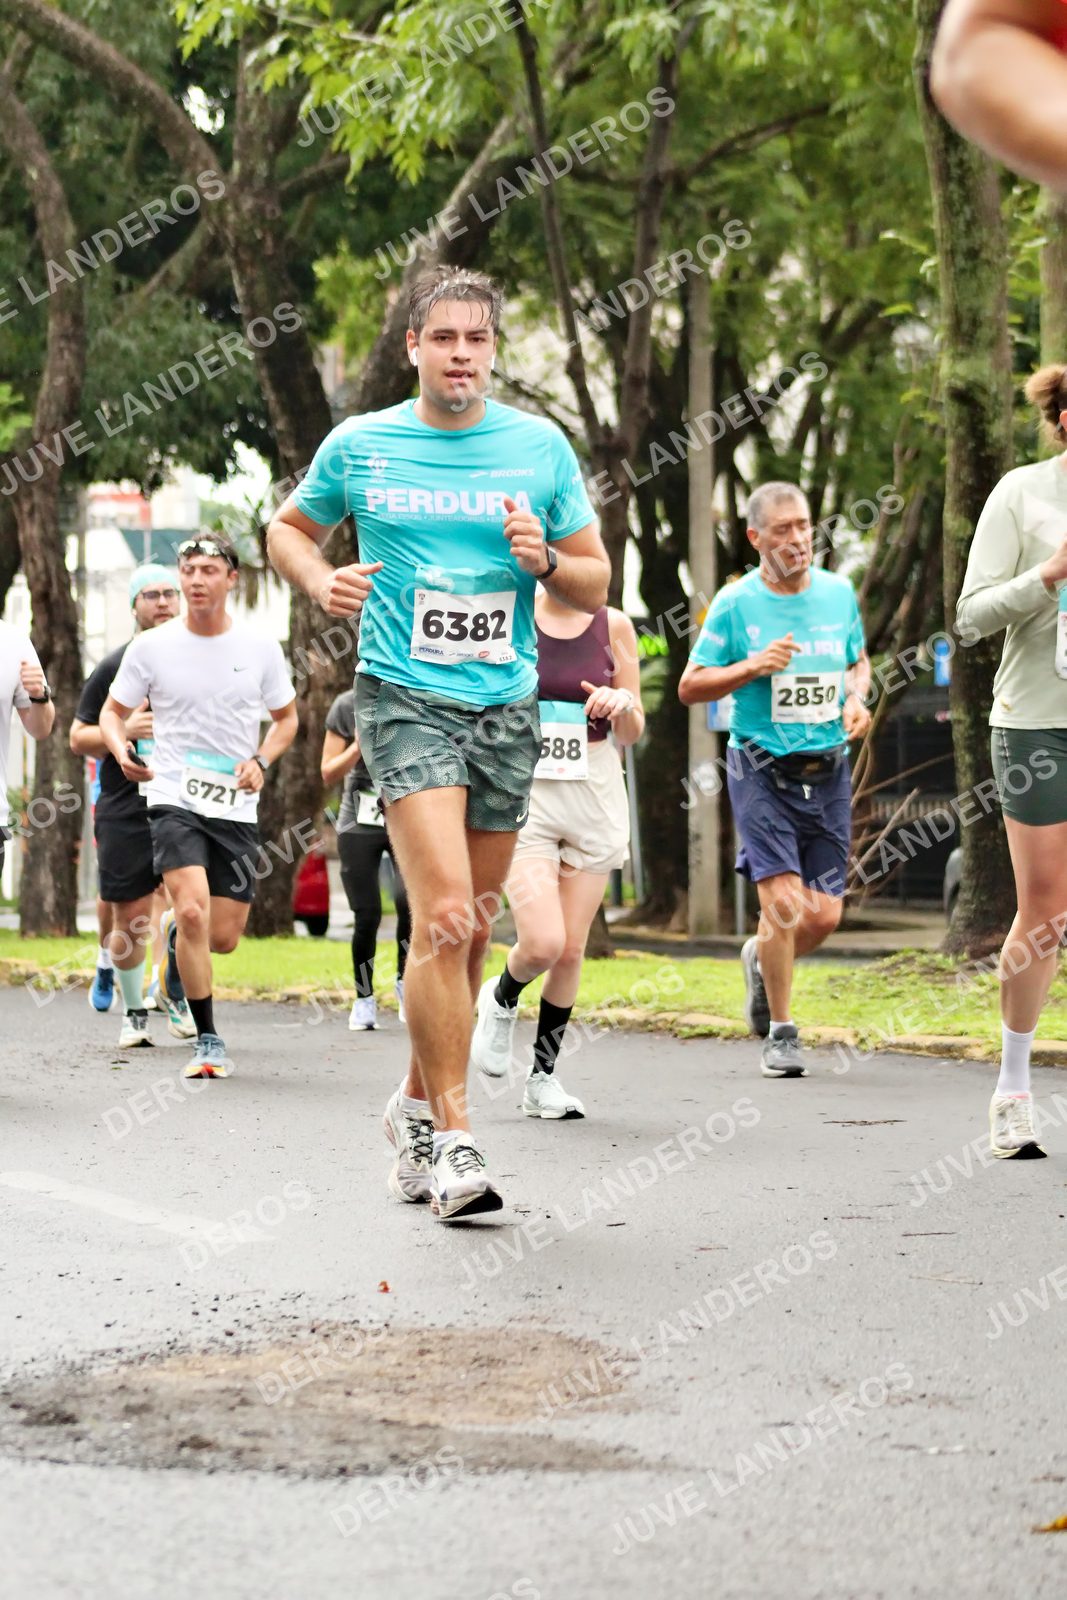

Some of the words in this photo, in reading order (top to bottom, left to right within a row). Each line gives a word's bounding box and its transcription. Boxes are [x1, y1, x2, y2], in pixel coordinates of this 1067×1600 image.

[365, 488, 532, 515] PERDURA
[422, 609, 507, 642] 6382
[777, 686, 836, 707] 2850
[186, 779, 237, 806] 6721
